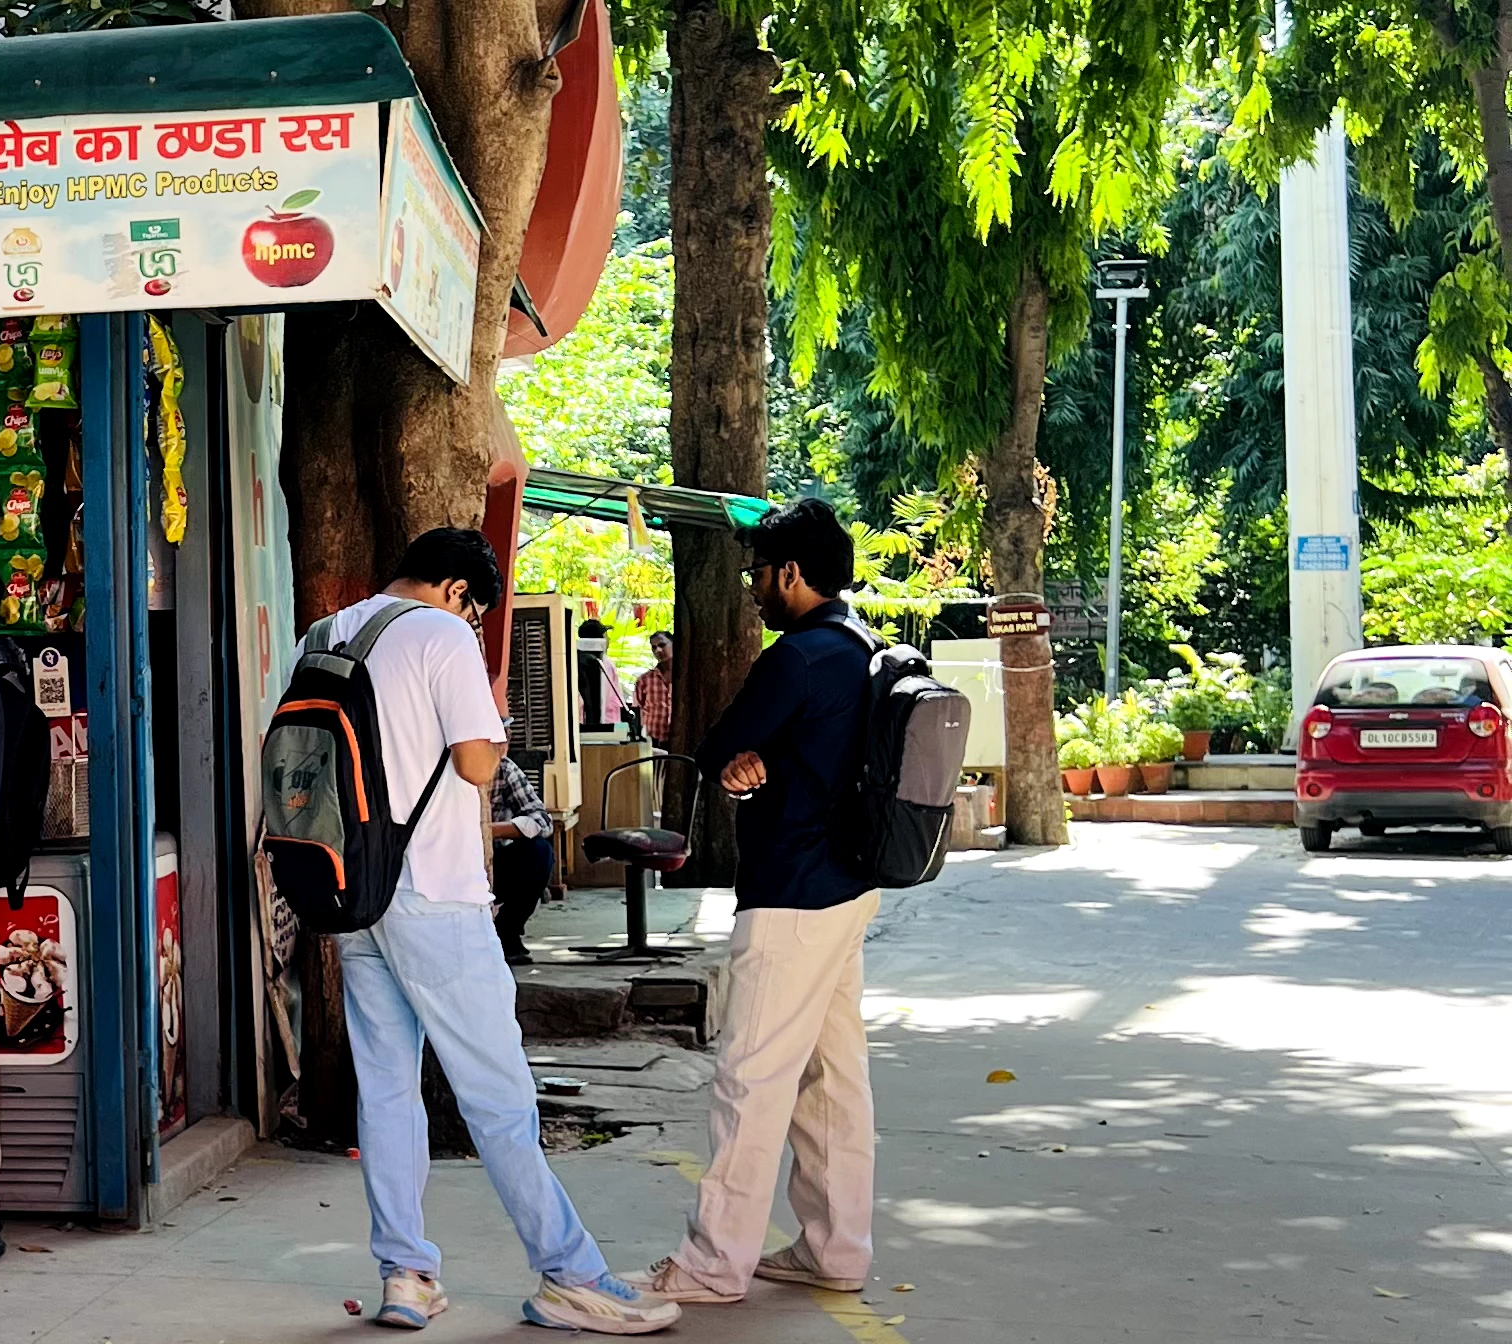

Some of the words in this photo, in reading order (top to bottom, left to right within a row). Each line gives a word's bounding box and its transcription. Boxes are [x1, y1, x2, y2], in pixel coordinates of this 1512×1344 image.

[73, 125, 142, 164] का
[154, 117, 266, 158] ठण्डा
[278, 112, 355, 153] रस
[66, 172, 148, 202] HPMC
[154, 165, 279, 197] Products
[254, 241, 316, 266] hpmc
[4, 415, 28, 426] Chips
[6, 500, 31, 512] Chips
[6, 583, 30, 594] Chips
